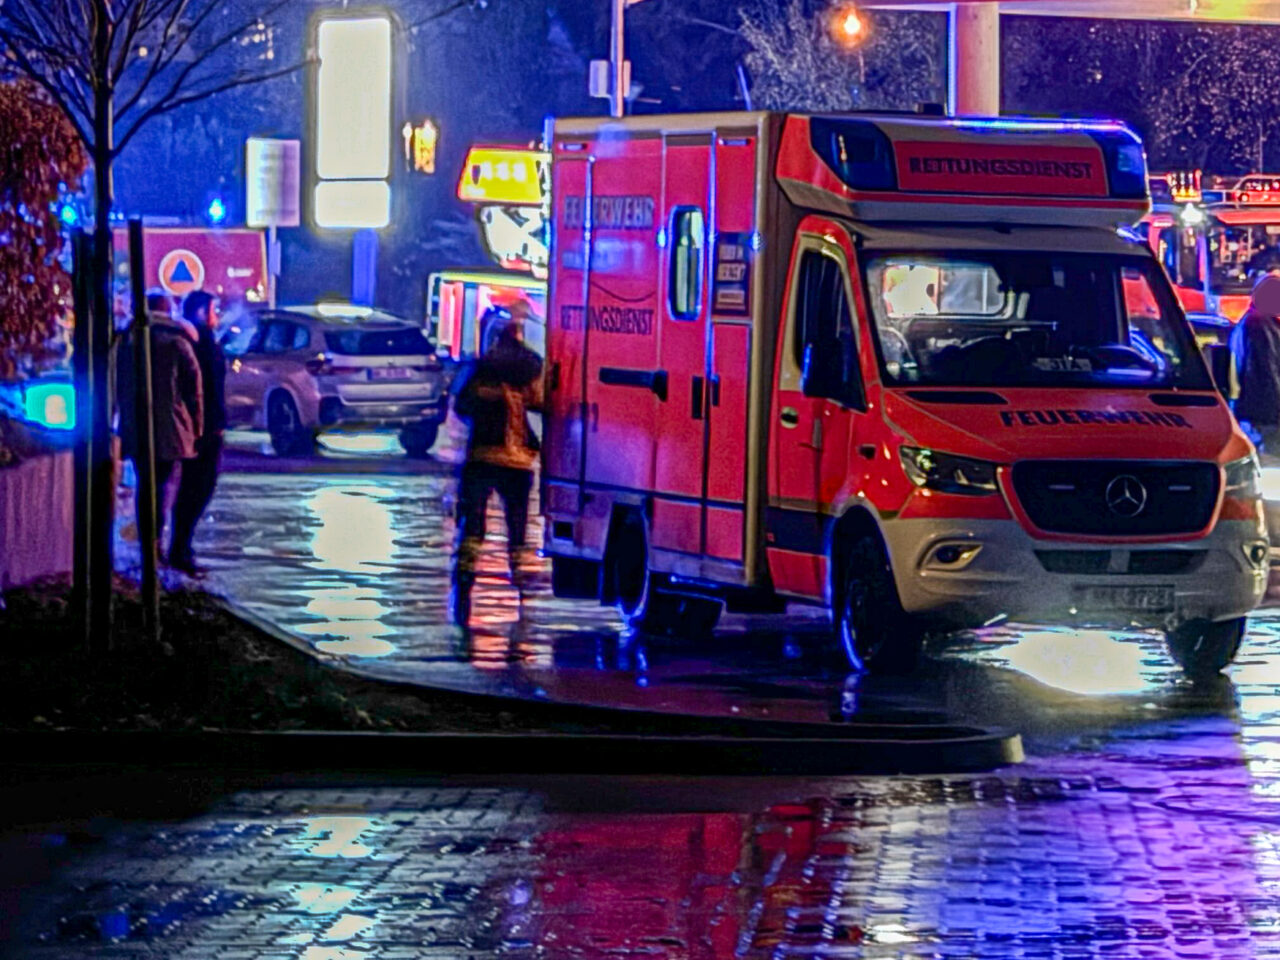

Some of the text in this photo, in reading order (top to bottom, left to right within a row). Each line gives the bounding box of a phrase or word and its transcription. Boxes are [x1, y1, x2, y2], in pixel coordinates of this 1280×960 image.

[909, 156, 1092, 179] RETTUNGSDIENST
[560, 304, 655, 336] RETTNGSDIENST
[1001, 409, 1193, 429] FEUERWEHR
